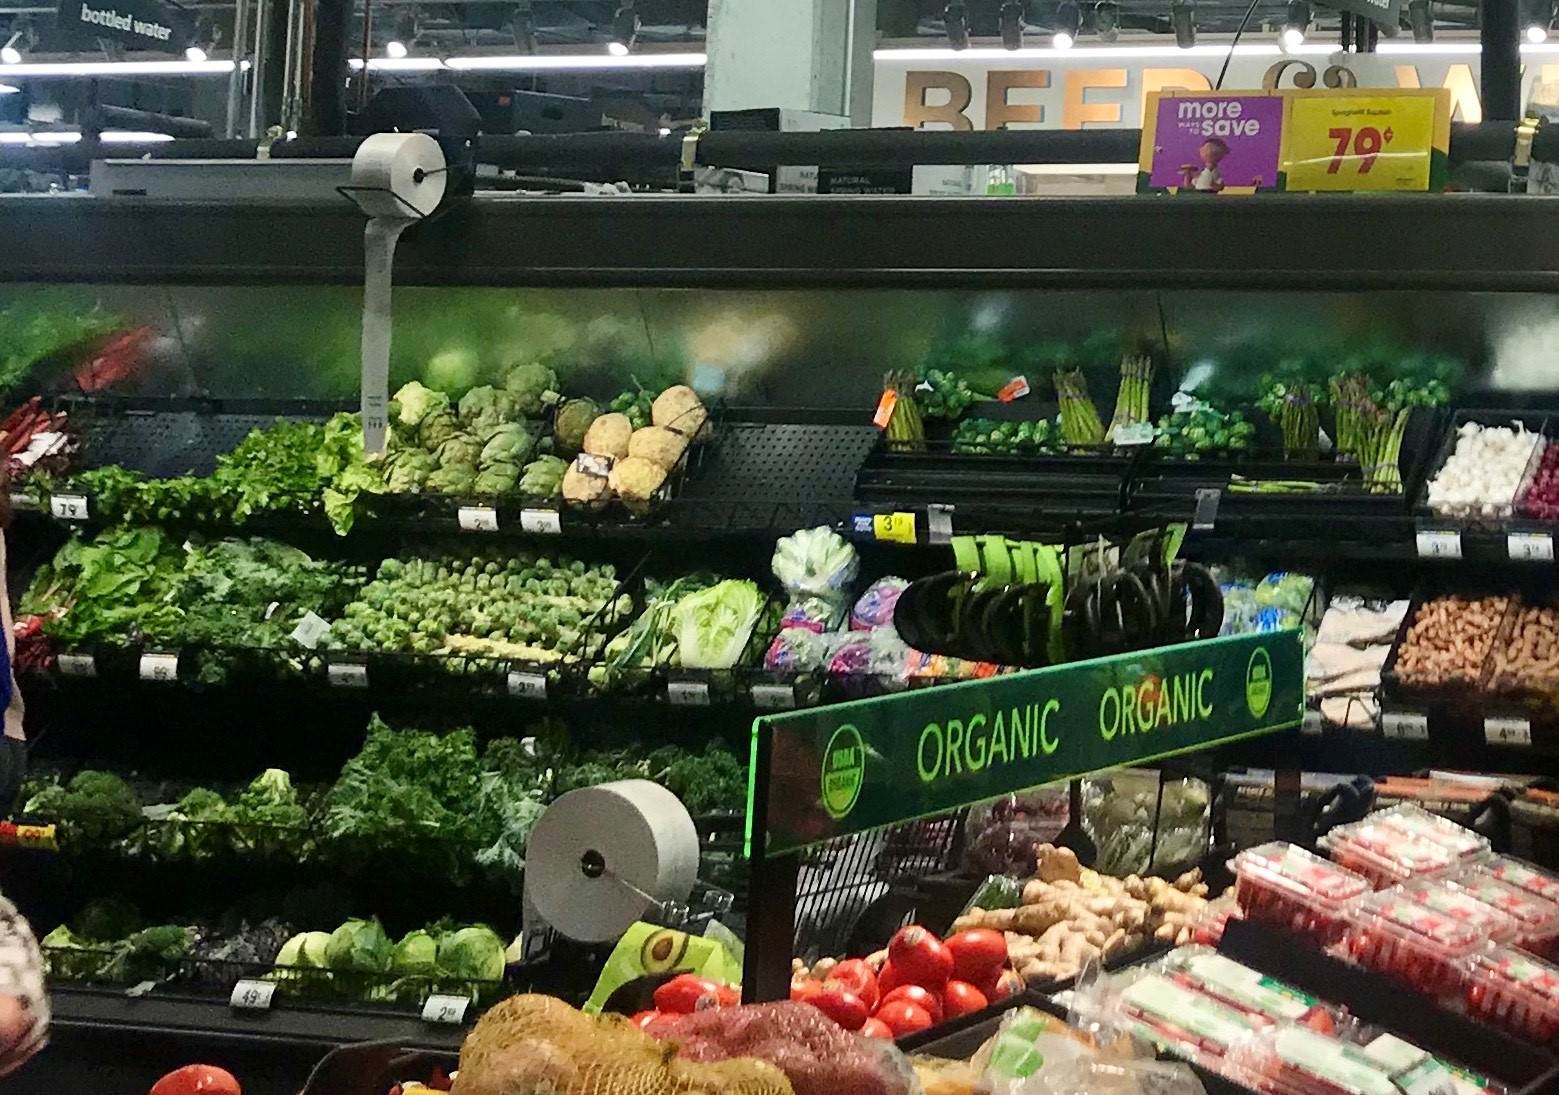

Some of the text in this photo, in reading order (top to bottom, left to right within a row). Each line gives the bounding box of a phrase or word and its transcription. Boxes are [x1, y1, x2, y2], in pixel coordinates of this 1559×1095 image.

[81, 2, 172, 41] bottled water
[903, 67, 1212, 130] BEE
[1178, 101, 1242, 119] more
[1202, 119, 1260, 136] save
[1100, 668, 1214, 741] ORGANIC
[917, 698, 1060, 782] ORGANIC
